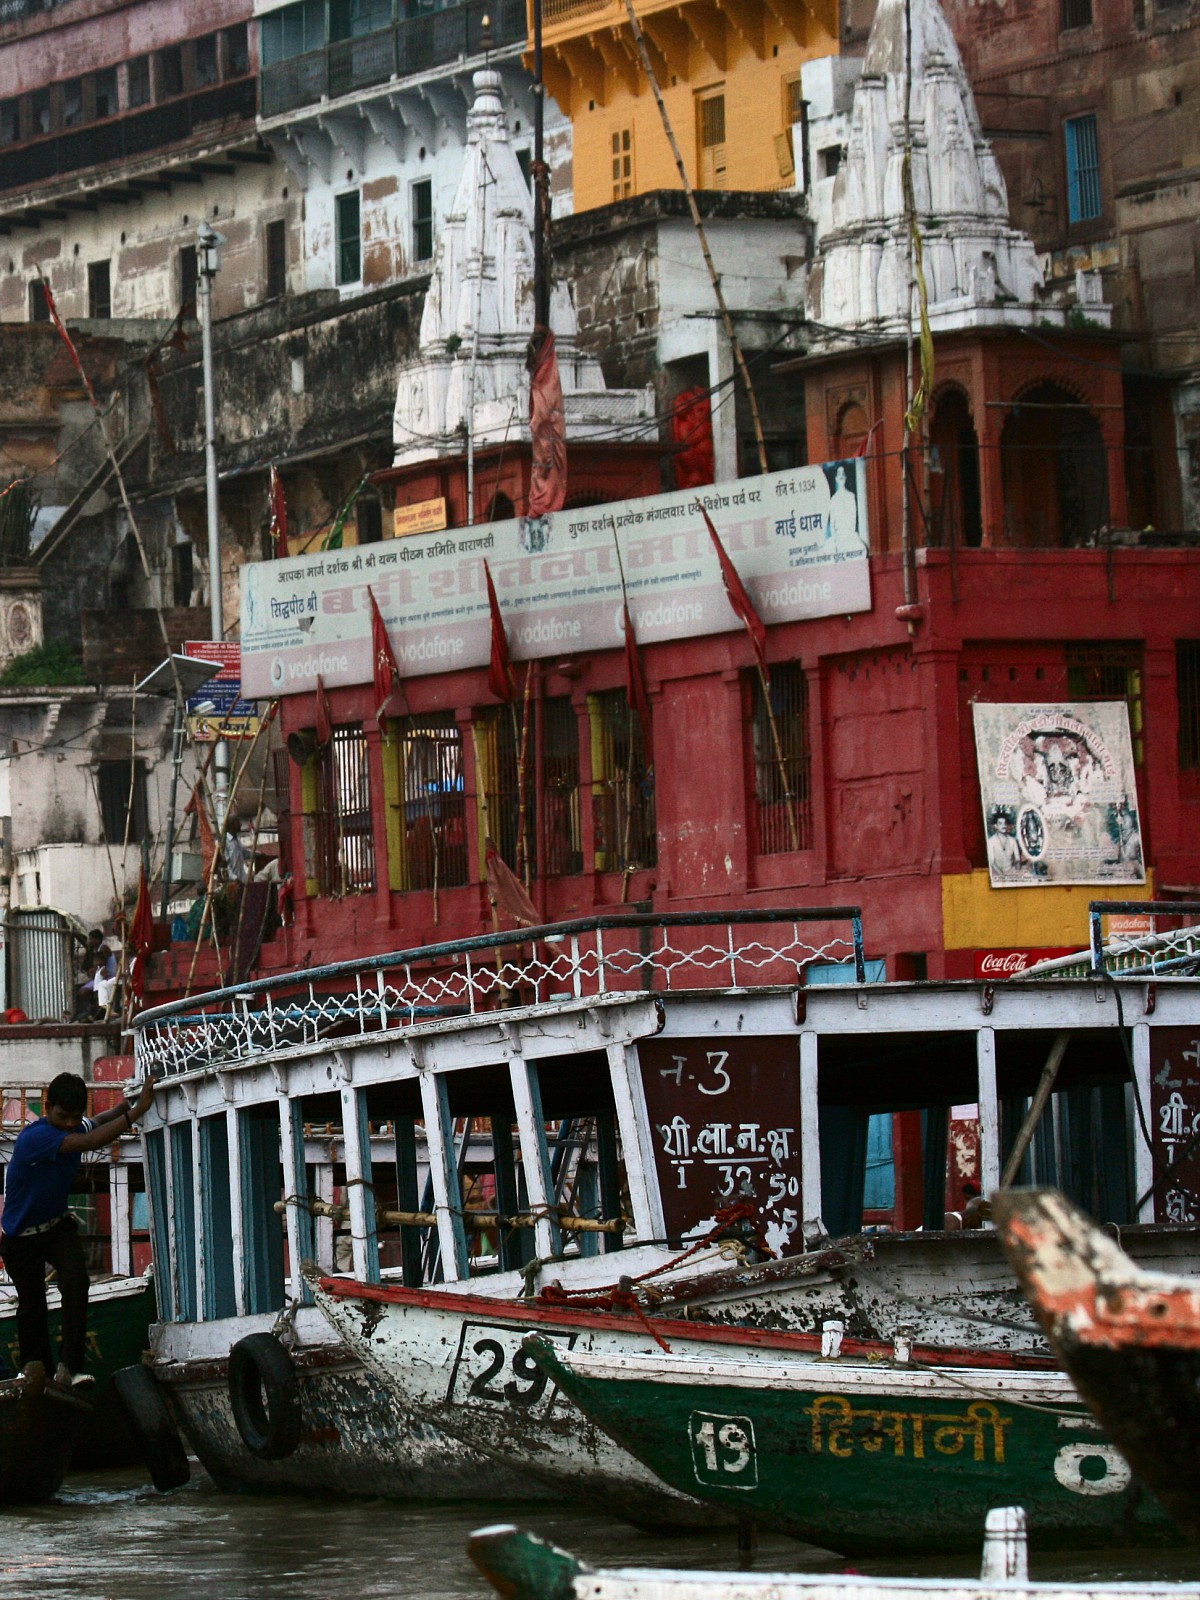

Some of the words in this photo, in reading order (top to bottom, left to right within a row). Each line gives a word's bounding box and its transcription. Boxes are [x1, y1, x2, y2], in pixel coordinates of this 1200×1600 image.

[569, 519, 590, 539] गुफा
[616, 508, 644, 529] प्रत्येक
[646, 503, 685, 522] मंगलवार
[703, 493, 730, 511] विशेष
[732, 488, 746, 505] पर्व
[748, 490, 762, 505] पर
[775, 509, 797, 538] माई
[800, 513, 823, 532] धाम
[627, 516, 772, 569] माता
[278, 569, 305, 584] आपका
[306, 563, 324, 578] मार्ग
[326, 559, 349, 576] दर्शक
[351, 556, 363, 571] श्री
[365, 553, 376, 569] श्री
[379, 553, 398, 566] यन्त्र
[399, 547, 425, 563] पीठम
[427, 541, 456, 558] समिति
[458, 532, 495, 551] वाराणसी
[271, 593, 305, 619] सिद्धपीठ
[307, 590, 318, 612] श्री
[760, 579, 831, 608] vodafone
[637, 600, 703, 628] vodafone
[516, 618, 582, 644] vodafone
[400, 636, 464, 662] vodafone
[288, 653, 348, 678] vodafone
[470, 1339, 548, 1405] 29
[803, 1395, 1014, 1462] हिमानी
[696, 1421, 750, 1473] 19
